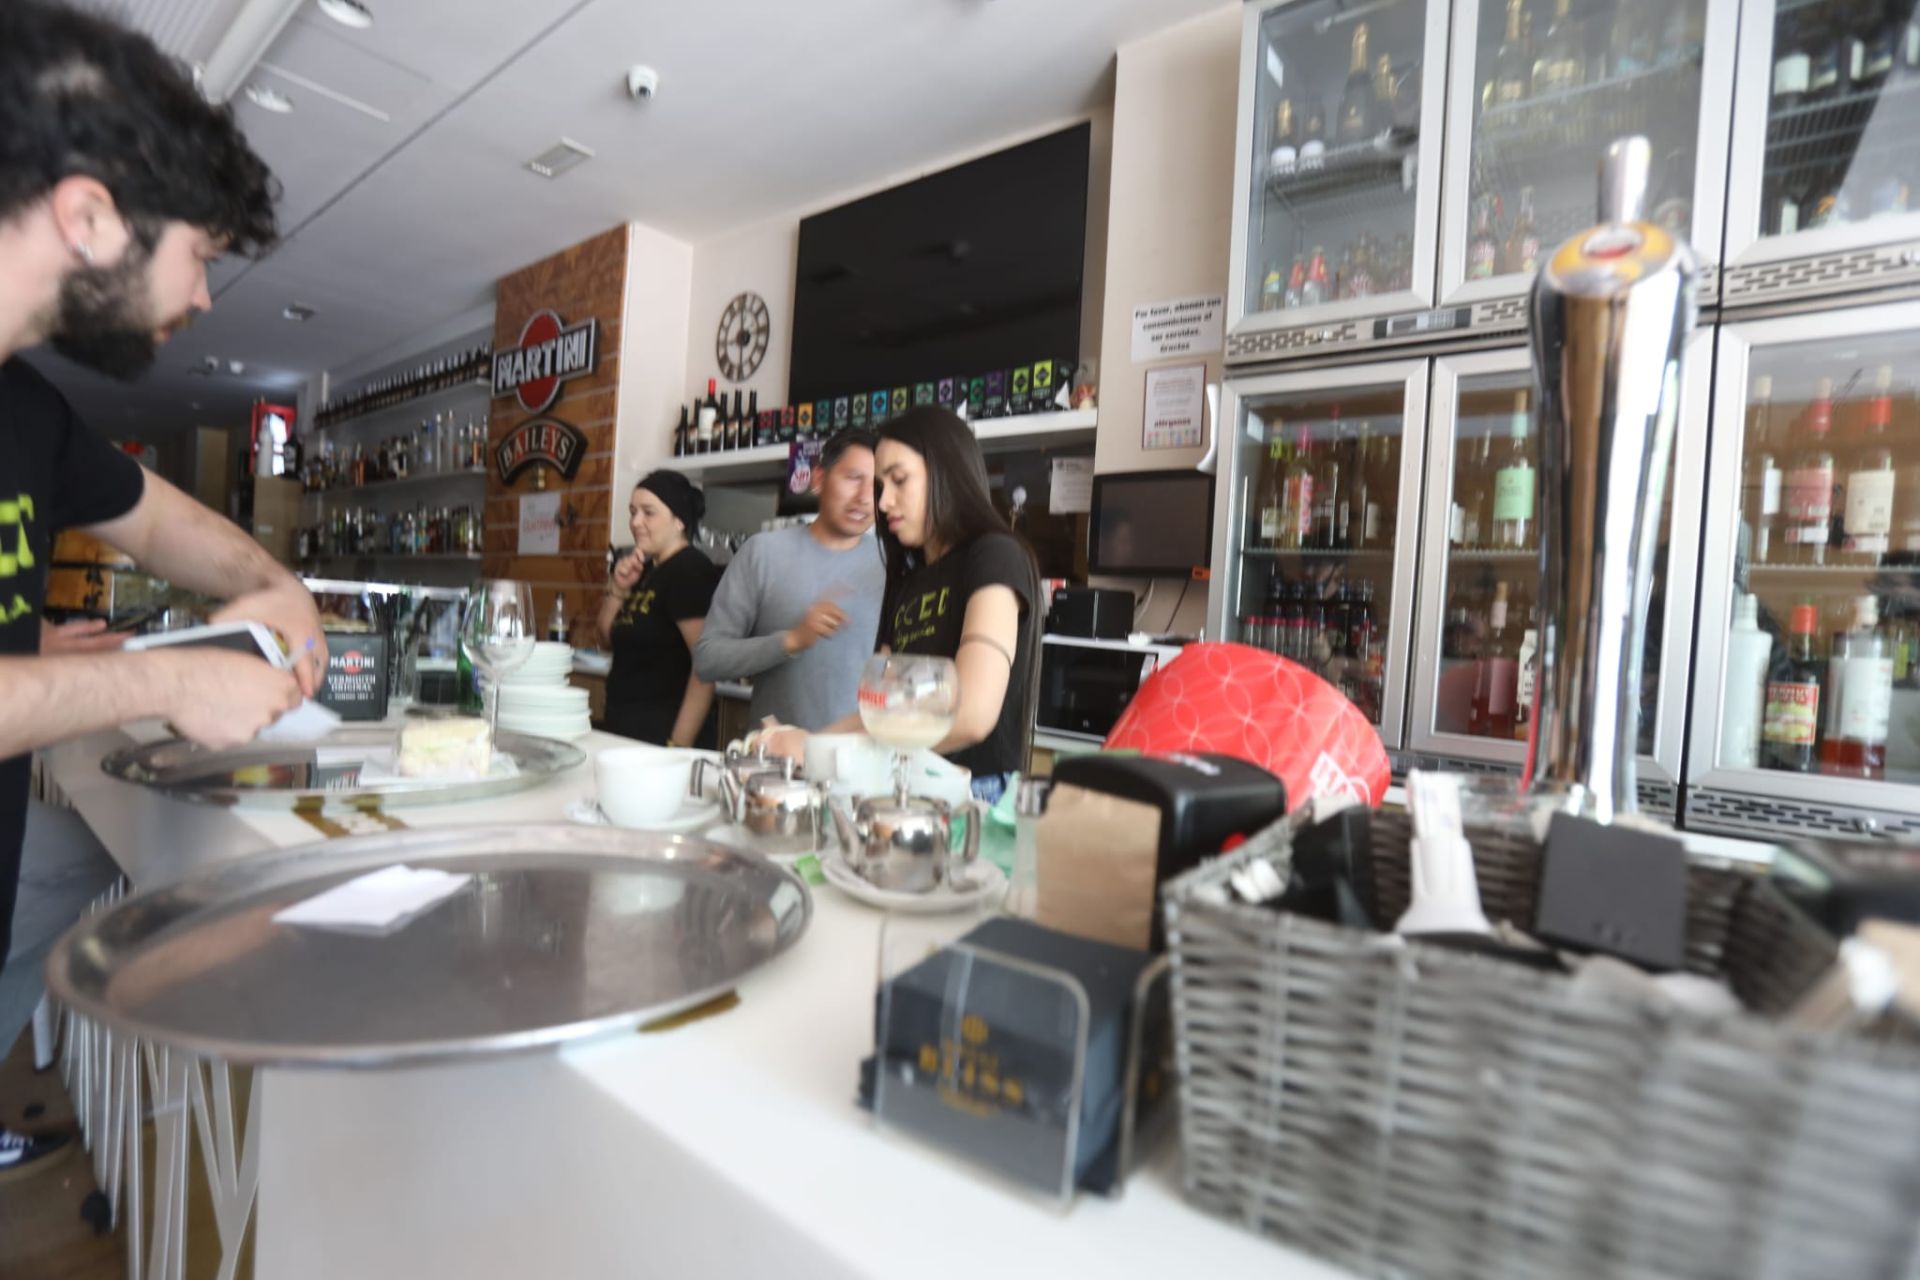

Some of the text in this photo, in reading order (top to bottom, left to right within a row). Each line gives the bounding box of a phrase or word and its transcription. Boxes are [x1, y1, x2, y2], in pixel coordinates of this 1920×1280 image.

[497, 328, 587, 392] MARTINI
[503, 423, 570, 468] BAILEYS
[330, 655, 375, 668] MARTINI
